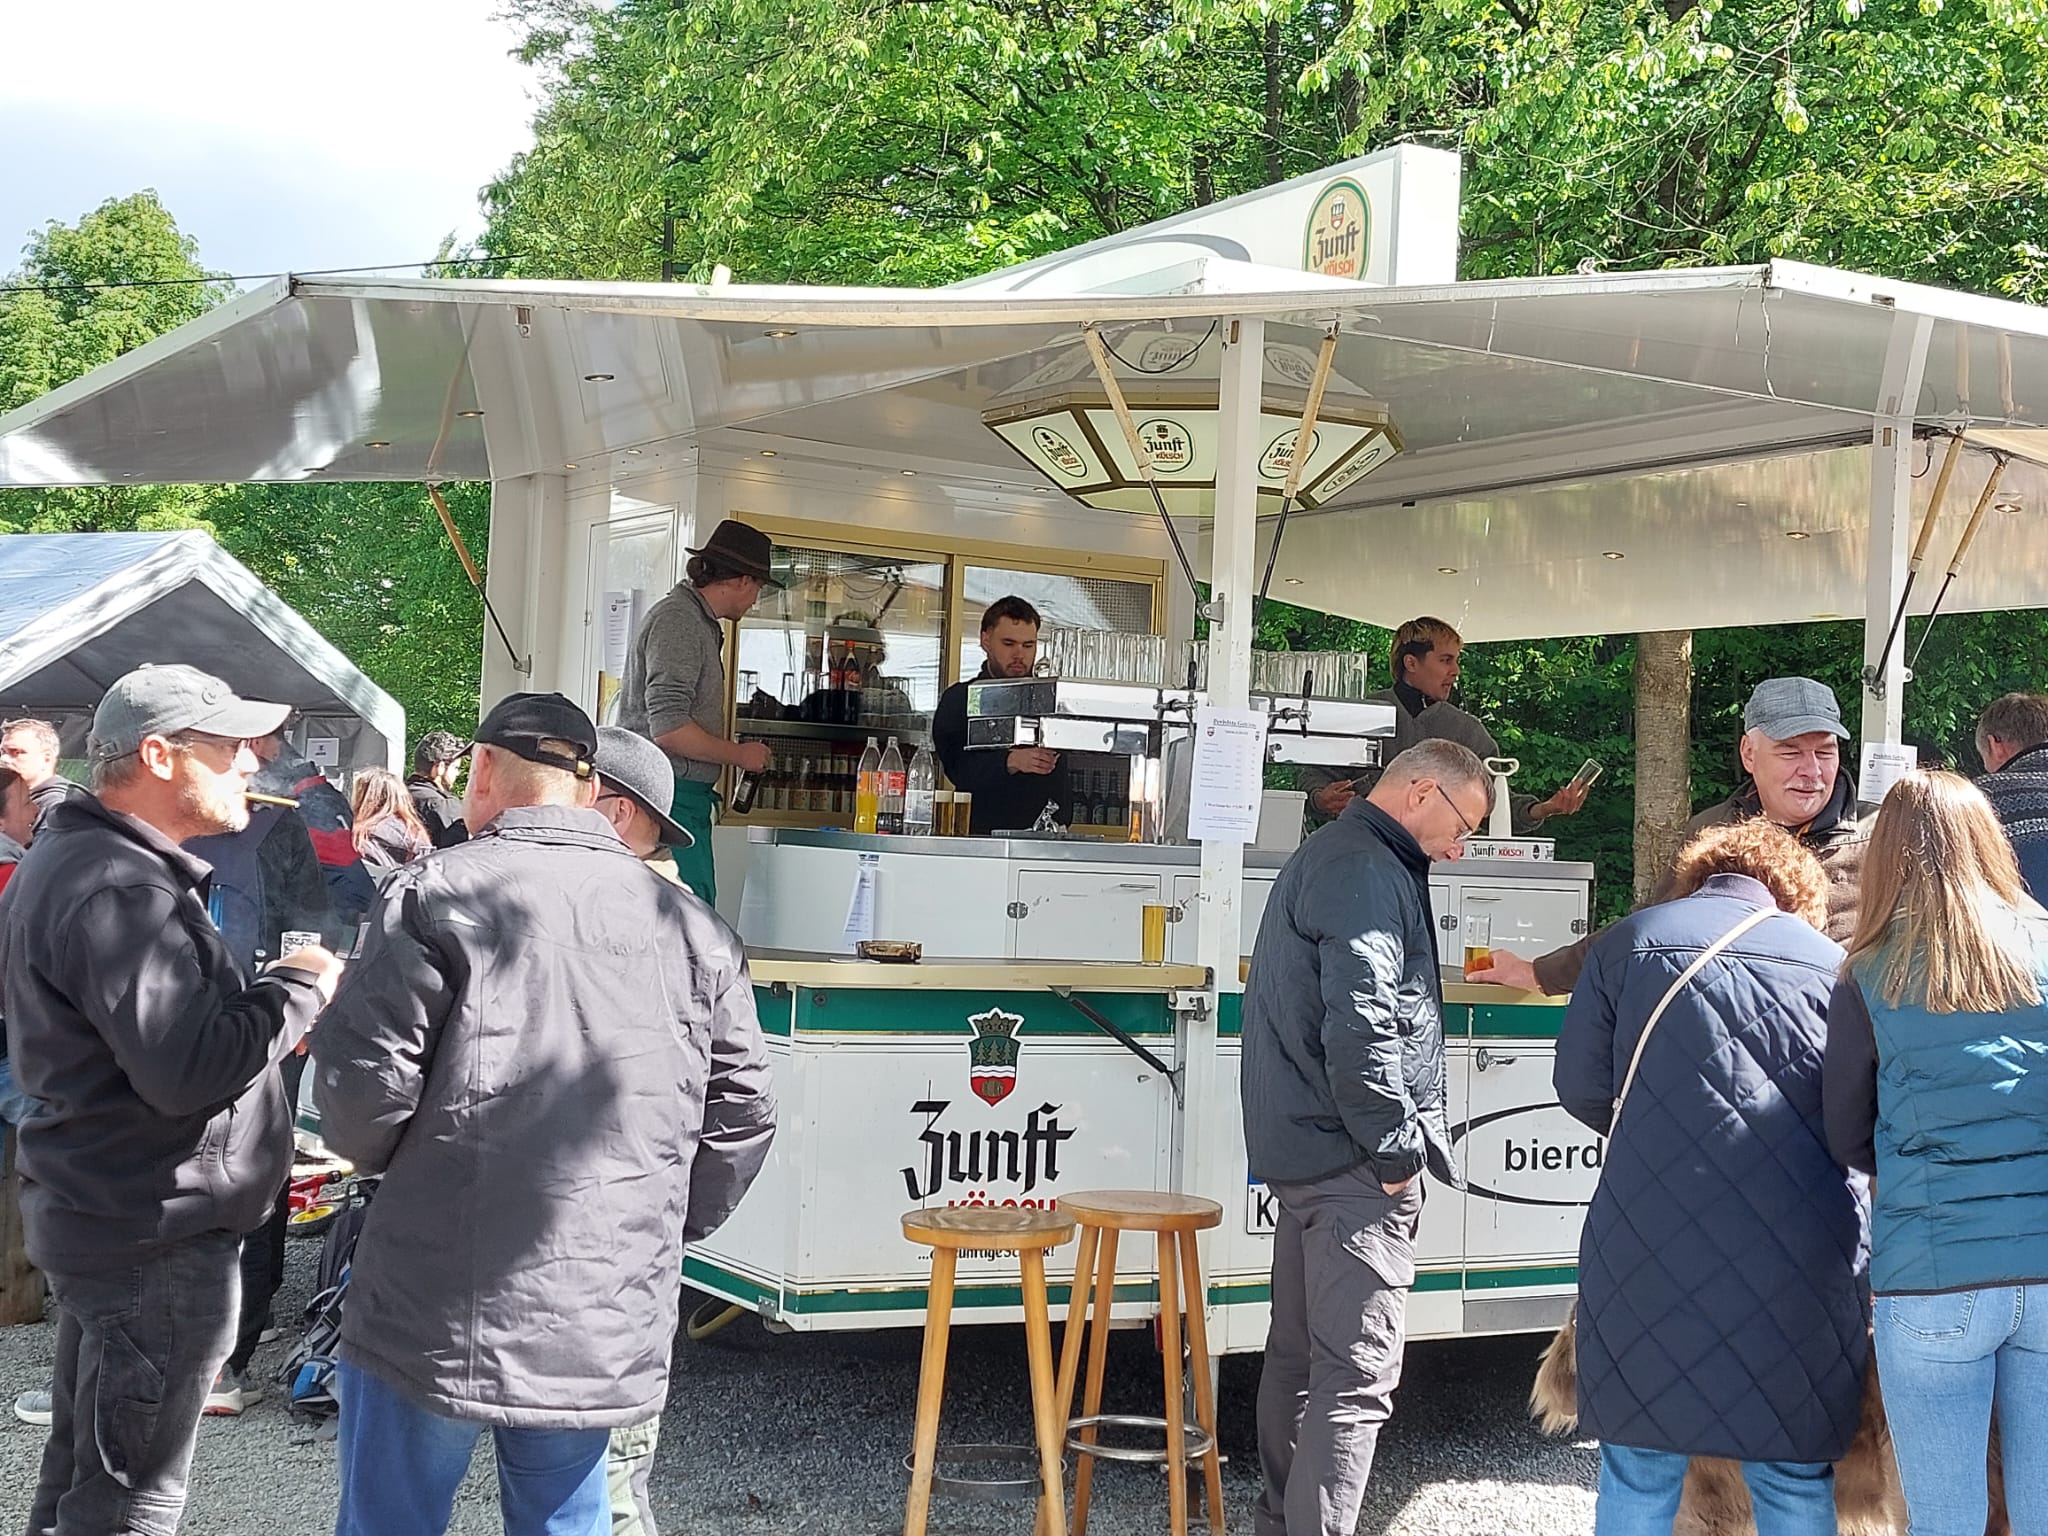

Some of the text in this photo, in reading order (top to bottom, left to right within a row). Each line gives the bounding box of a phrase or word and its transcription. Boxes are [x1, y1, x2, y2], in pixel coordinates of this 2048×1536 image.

[1313, 221, 1360, 268] Zunft
[1324, 258, 1355, 276] KÖLSCH
[1143, 436, 1185, 453] Zunft
[1471, 843, 1524, 857] Zunft KÖLSCH
[899, 1100, 1078, 1201] Zunft
[1505, 1137, 1602, 1172] bierd
